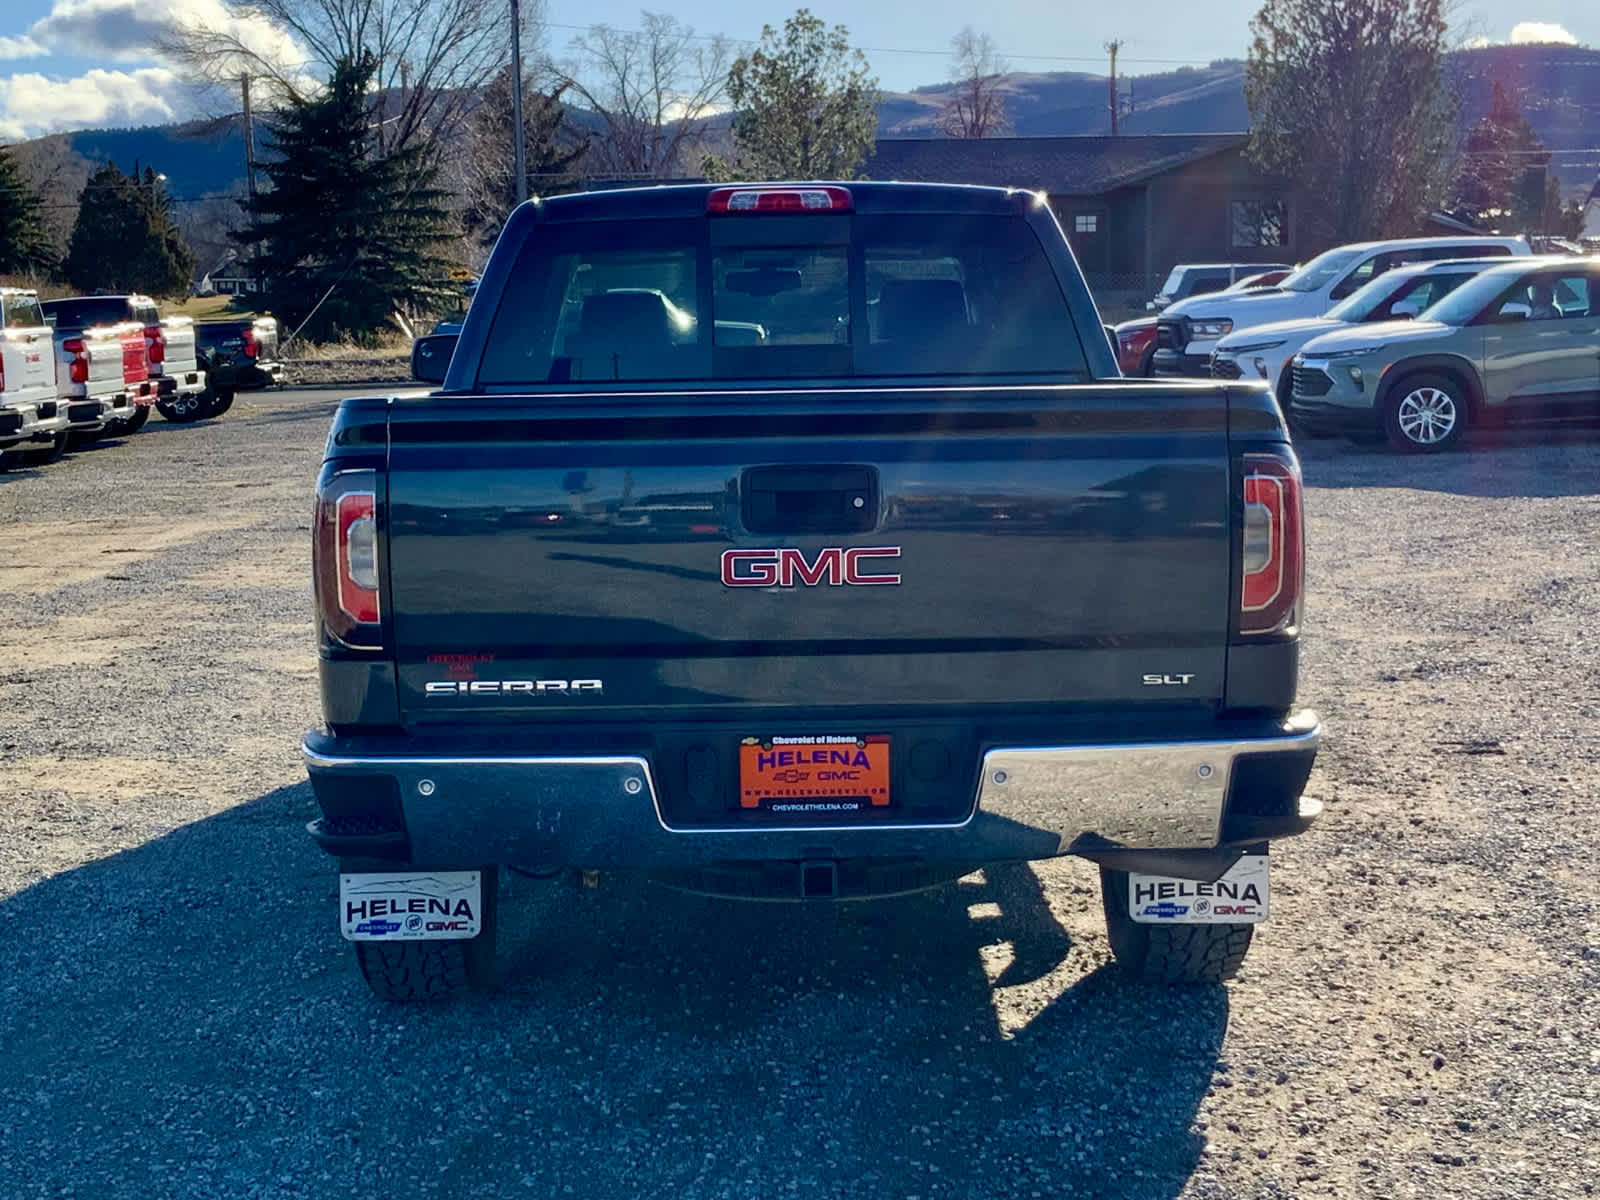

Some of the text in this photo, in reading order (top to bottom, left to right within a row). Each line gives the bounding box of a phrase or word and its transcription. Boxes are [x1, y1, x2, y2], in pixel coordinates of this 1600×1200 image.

[720, 546, 901, 587] GMC
[1143, 673, 1195, 685] SLT
[425, 679, 603, 696] SIERRA
[772, 736, 815, 745] Chevrolet
[816, 736, 825, 744] of
[826, 735, 857, 744] Helena
[758, 750, 871, 772] HELENA
[817, 771, 860, 781] GMC
[772, 803, 859, 812] CHEVROLETHELENA.COM
[1135, 882, 1263, 906] HELENA
[346, 898, 474, 924] HELENA
[1213, 905, 1256, 915] GMC
[425, 920, 469, 932] GMC
